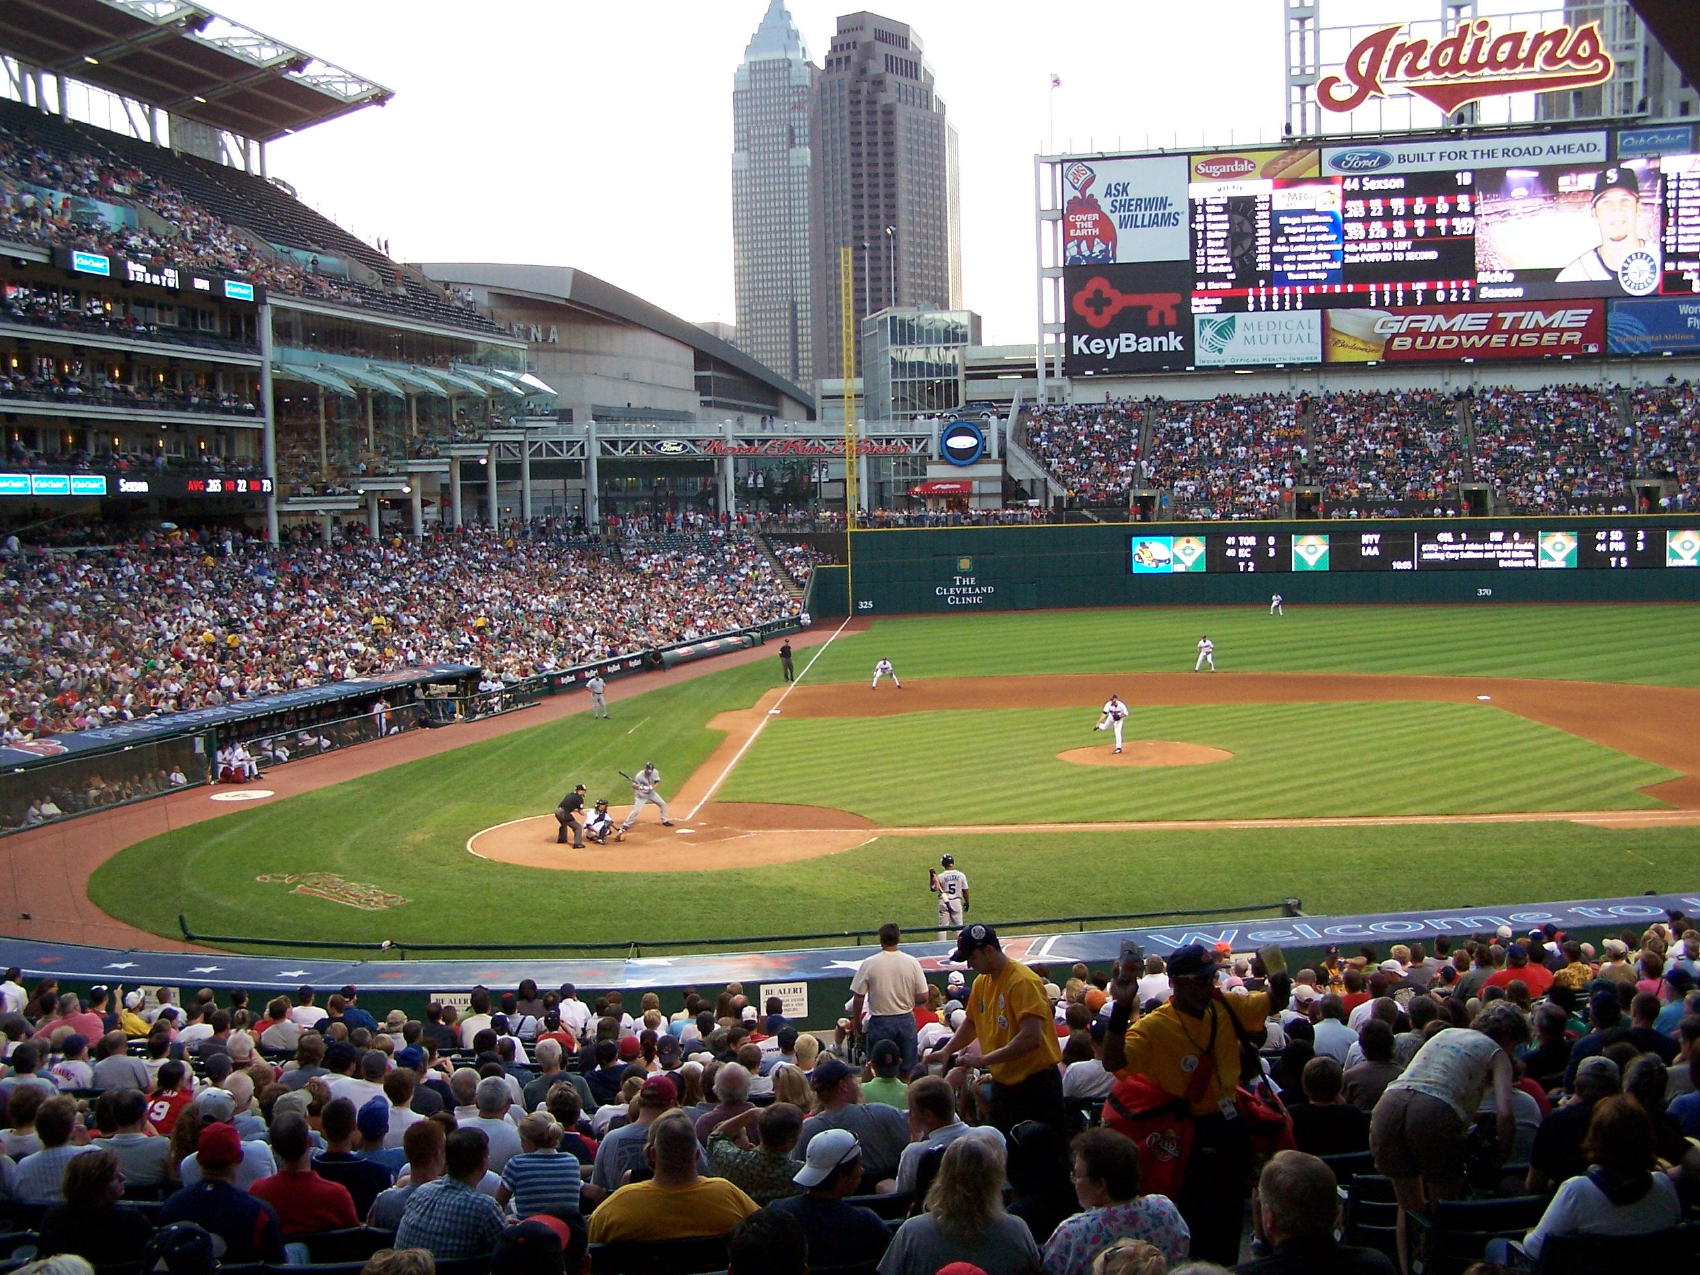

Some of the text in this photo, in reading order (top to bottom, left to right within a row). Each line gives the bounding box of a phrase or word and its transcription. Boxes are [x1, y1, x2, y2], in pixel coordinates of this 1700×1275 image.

[1316, 17, 1615, 113] Indians
[1342, 142, 1601, 170] Ford BUILT FOR THE ROAD AHEAD.
[1196, 157, 1256, 176] Sugardale
[1104, 182, 1131, 198] ASK
[1343, 178, 1360, 191] 44
[1110, 196, 1174, 214] SHERWIN-
[1069, 213, 1099, 221] COVER
[1119, 211, 1180, 229] WILLIAMS
[1075, 221, 1093, 229] THE
[1069, 228, 1099, 236] EARTH
[1450, 289, 1458, 301] 2
[1462, 289, 1470, 301] 2
[1243, 319, 1314, 332] MEDICAL
[1374, 308, 1594, 335] GAME TIME
[1072, 331, 1184, 359] KeyBank
[1243, 333, 1315, 345] MUTUAL
[1391, 332, 1583, 351] BUDWEISER
[661, 441, 684, 453] Ford
[1247, 561, 1254, 572] 2
[953, 576, 976, 586] THE
[935, 585, 995, 595] CLEVELAND
[1477, 588, 1491, 596] 370
[858, 600, 873, 609] 325
[947, 594, 983, 605] CLINIC
[949, 884, 956, 894] 5
[1147, 911, 1563, 949] Welcome
[1567, 904, 1665, 920] to
[778, 987, 803, 995] ALERT
